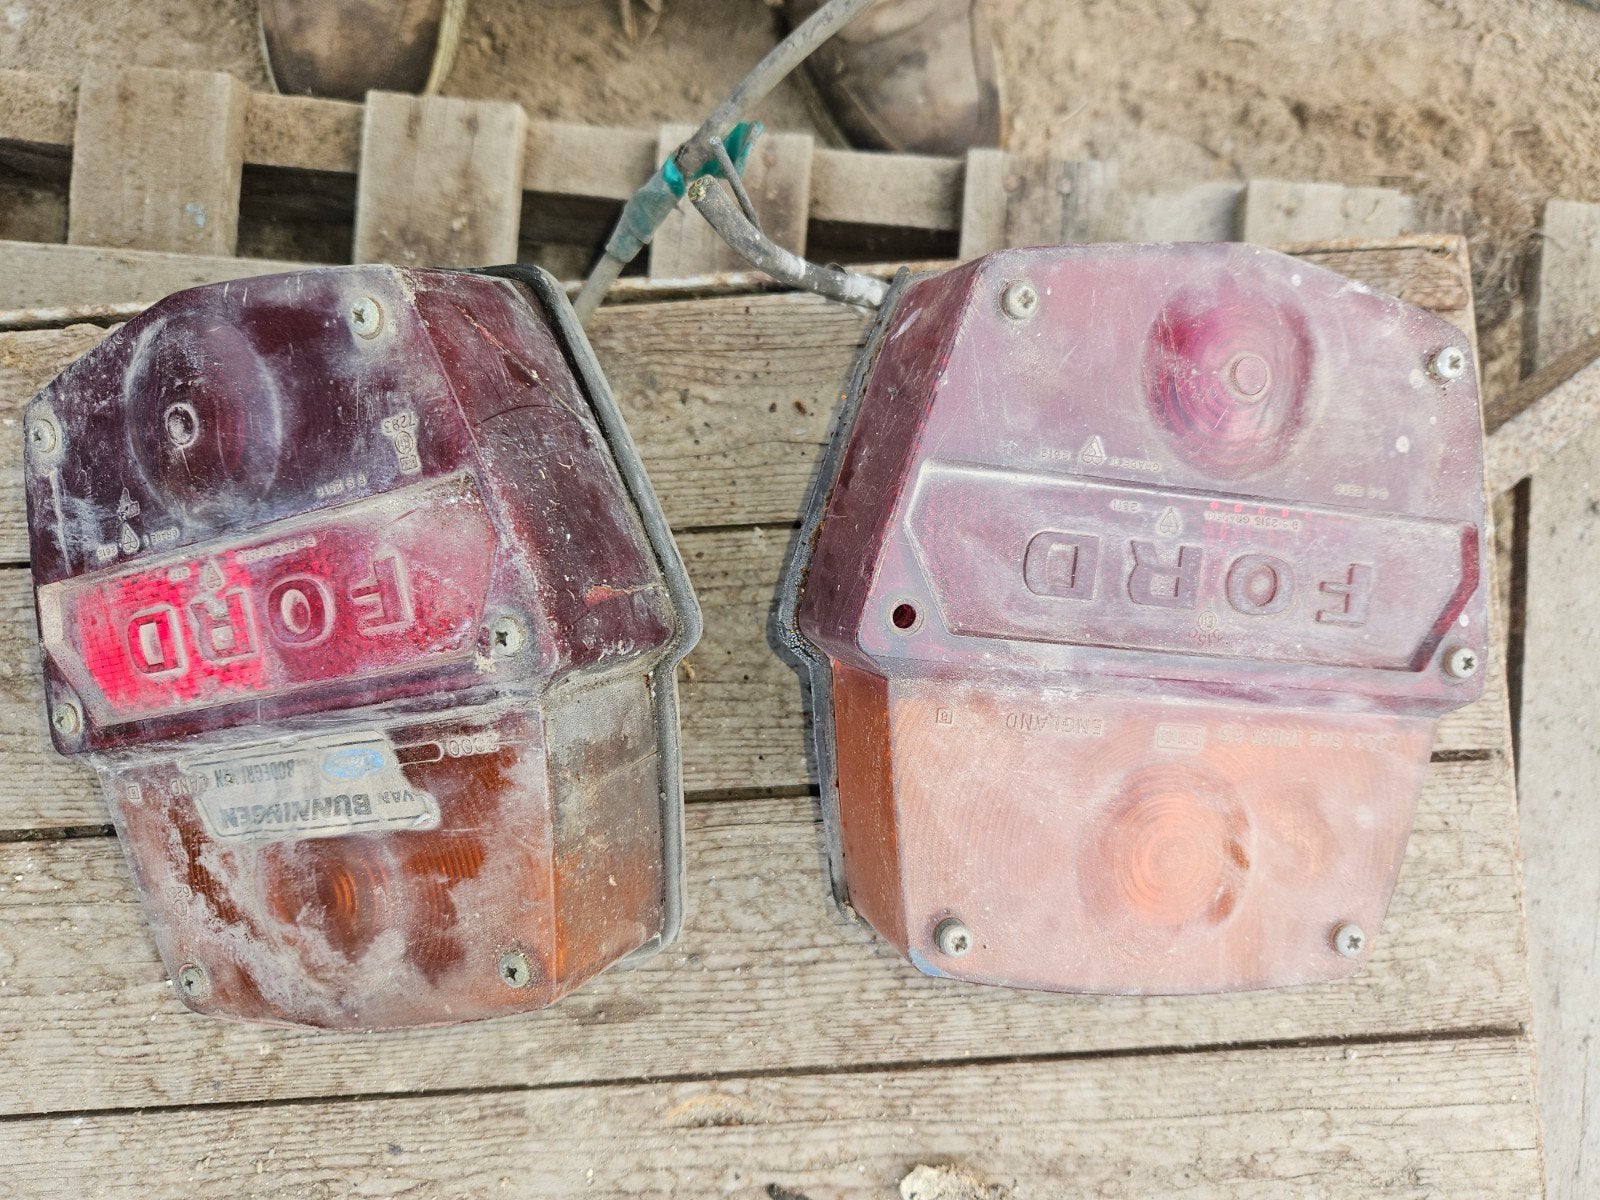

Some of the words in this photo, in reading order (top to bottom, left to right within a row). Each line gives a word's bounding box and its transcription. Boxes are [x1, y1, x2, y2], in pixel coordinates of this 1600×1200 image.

[384, 415, 416, 433] 7283
[1122, 458, 1159, 472] GRADE
[1215, 510, 1251, 524] GRADE
[150, 528, 178, 544] GRADE
[1023, 531, 1372, 629] FORD
[126, 550, 413, 677] FORD
[1005, 712, 1102, 736] ENGLAND
[376, 789, 414, 805] VAN
[219, 793, 372, 829] BUNNINGEN
